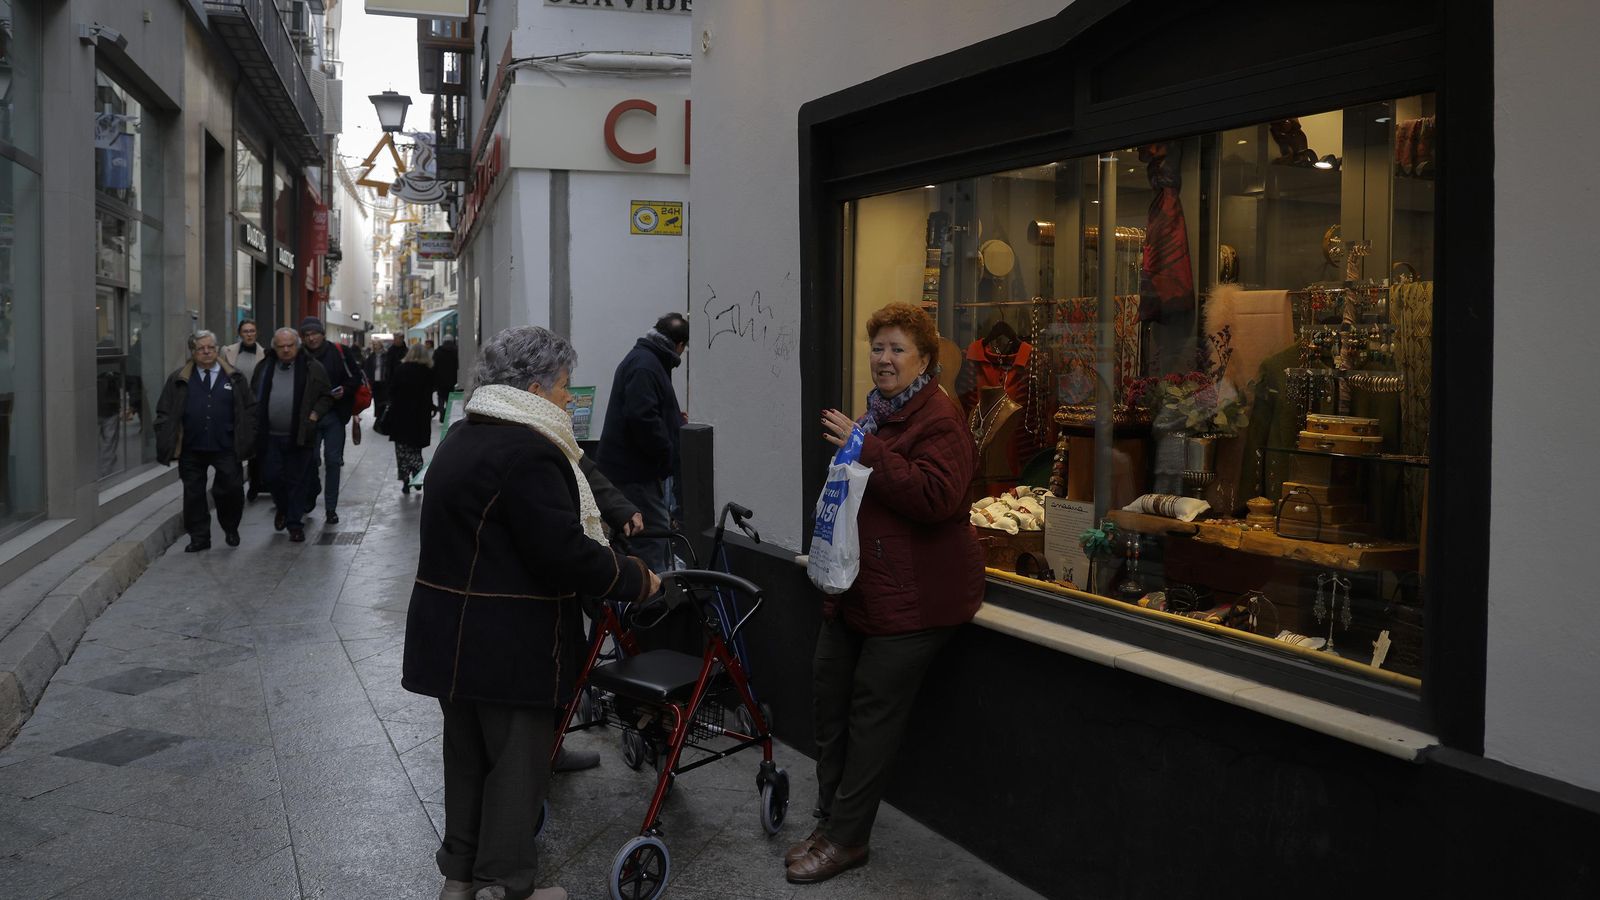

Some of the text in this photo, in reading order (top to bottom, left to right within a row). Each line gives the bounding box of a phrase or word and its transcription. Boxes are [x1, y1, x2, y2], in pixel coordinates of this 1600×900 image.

[545, 0, 692, 11] VIDE
[604, 99, 691, 165] C
[661, 207, 681, 215] 24H
